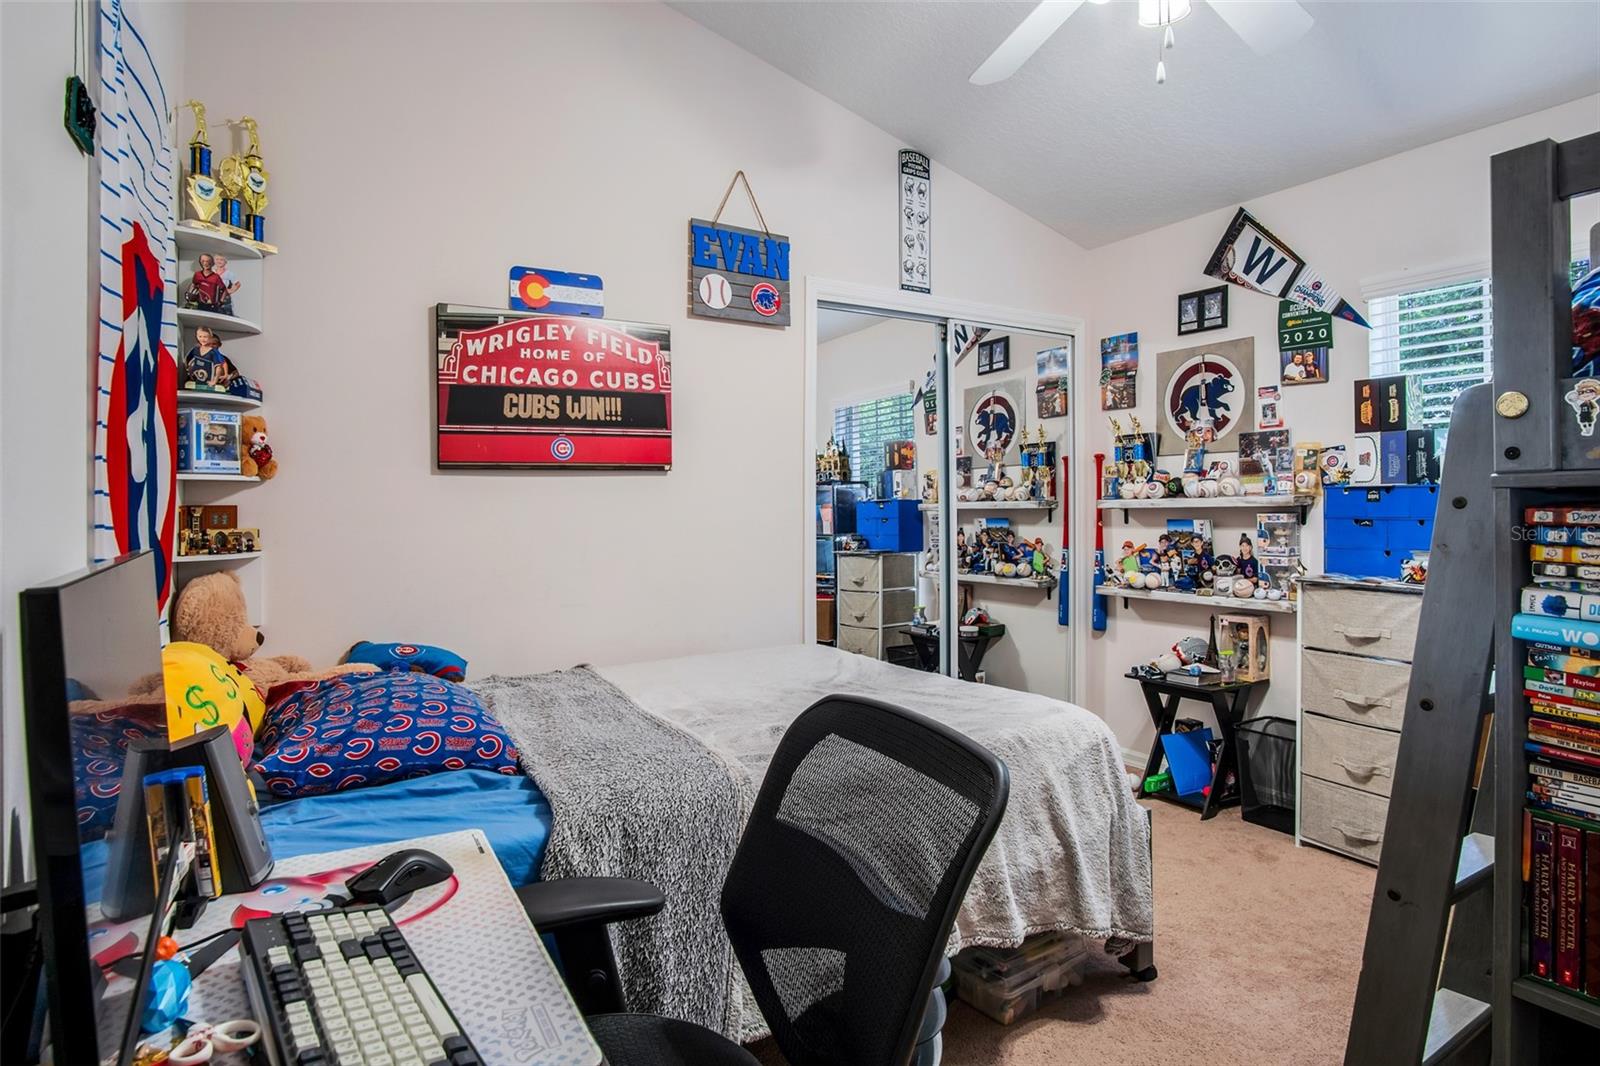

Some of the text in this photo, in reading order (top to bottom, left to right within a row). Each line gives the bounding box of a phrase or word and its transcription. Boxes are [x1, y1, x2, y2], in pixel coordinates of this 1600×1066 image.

[902, 152, 929, 169] BASEBALL
[691, 225, 791, 281] EVAN
[1242, 235, 1288, 285] W
[465, 323, 653, 366] WRIGLEY FIELD
[1282, 328, 1327, 344] 2020
[520, 348, 606, 363] HOME OF
[462, 365, 656, 391] CHICAGO CUBS
[504, 393, 622, 421] CUBS WIN!!!
[1532, 628, 1560, 637] PALACIO
[1534, 642, 1562, 652] GUTMAN
[1572, 678, 1596, 689] Naylor
[1542, 708, 1578, 718] CREECH
[1540, 853, 1550, 939] HARRY POTTER
[1566, 862, 1577, 950] HARRY POTTER
